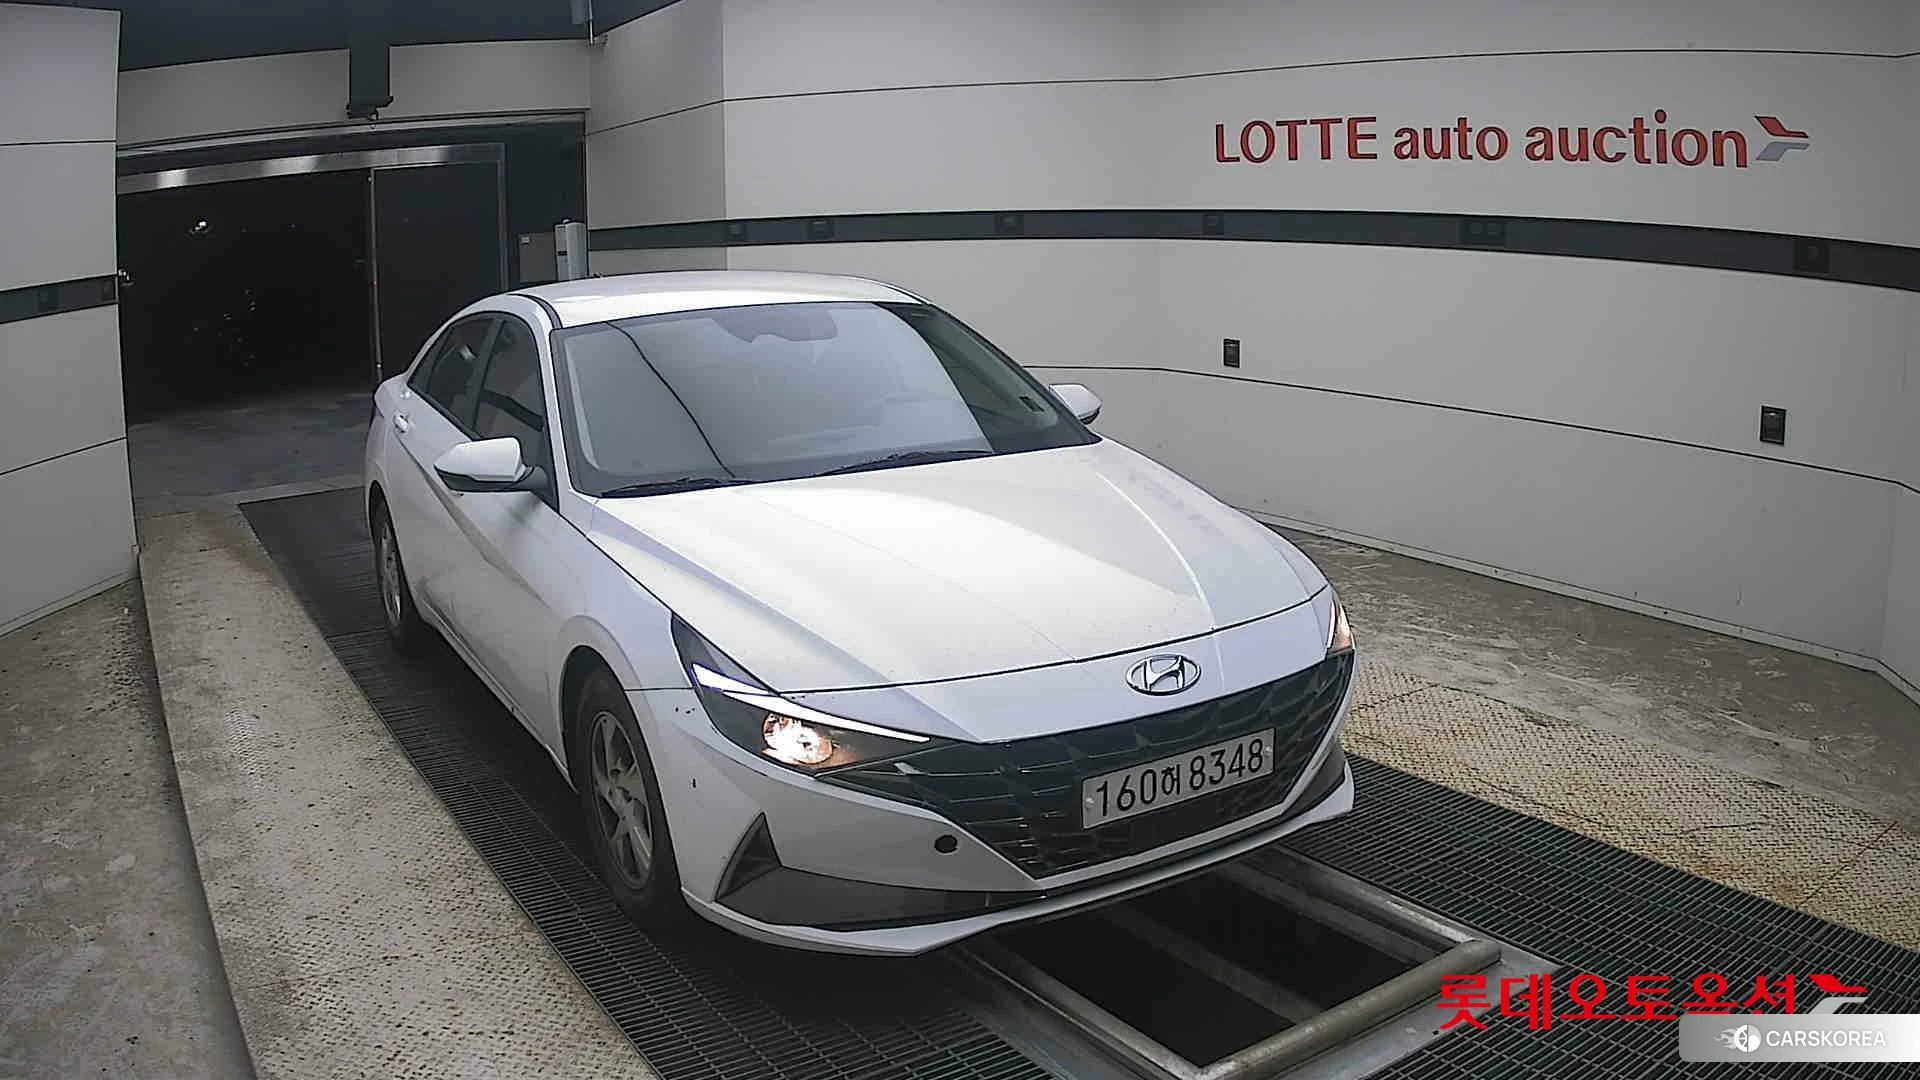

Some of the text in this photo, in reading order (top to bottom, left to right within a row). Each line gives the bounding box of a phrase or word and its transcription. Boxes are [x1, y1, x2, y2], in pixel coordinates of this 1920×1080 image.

[1215, 110, 1748, 168] LOTTE auto auction
